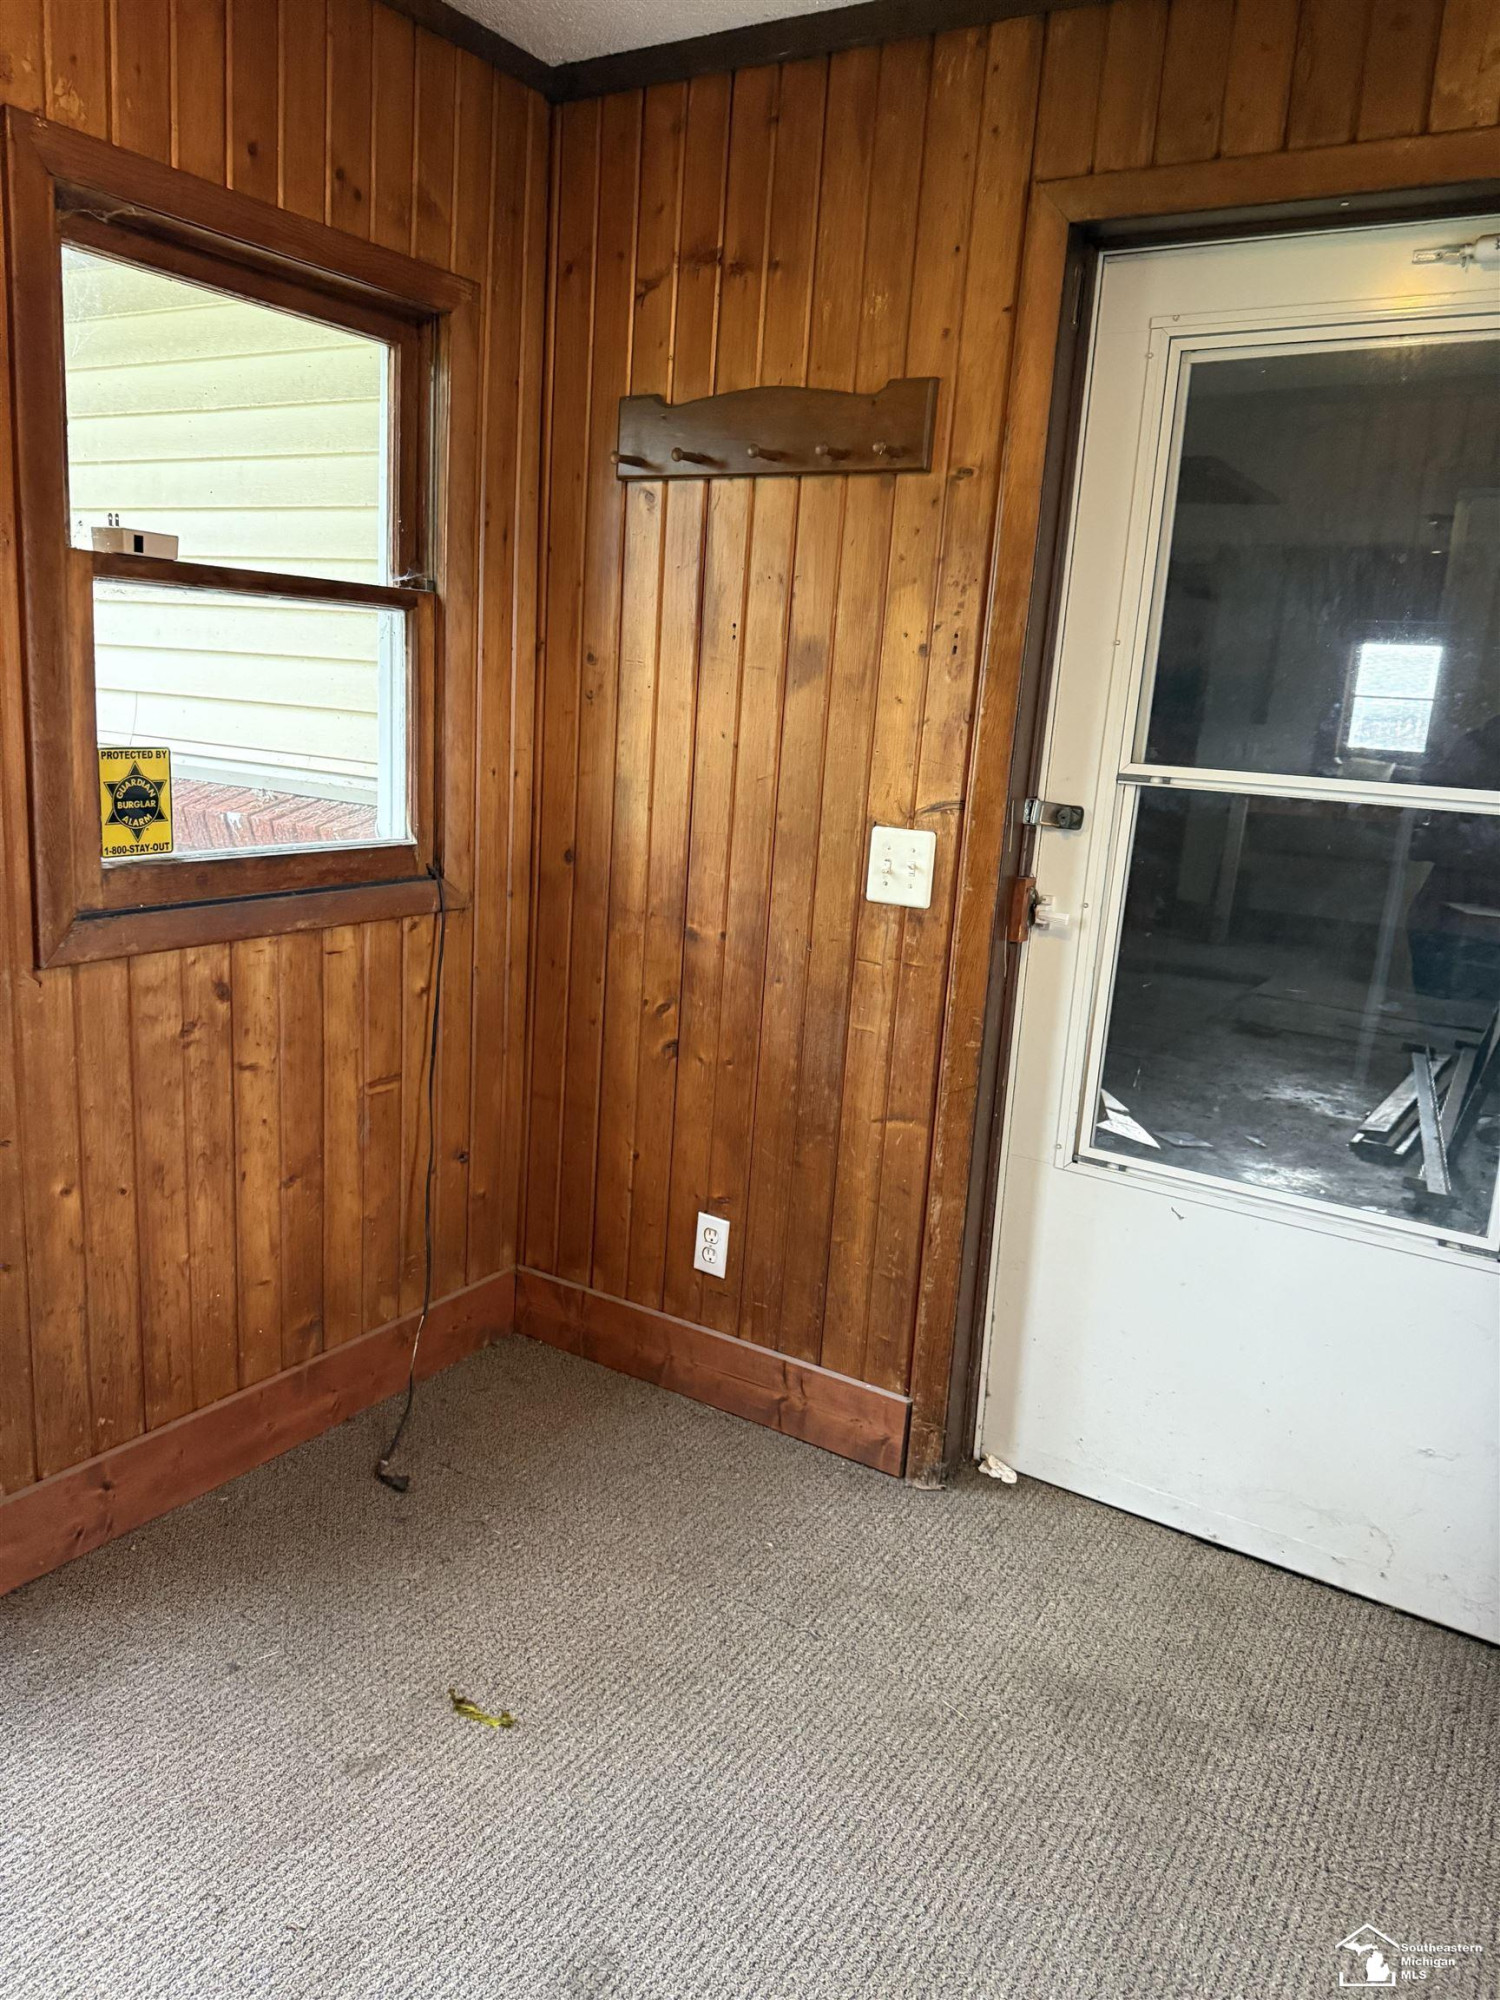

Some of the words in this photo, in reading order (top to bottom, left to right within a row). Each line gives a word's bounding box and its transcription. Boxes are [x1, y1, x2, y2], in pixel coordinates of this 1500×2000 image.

[100, 750, 153, 760] PROTECTED
[155, 750, 167, 759] BY
[116, 778, 156, 799] GUARDIAN
[117, 800, 156, 809] BURGLAR
[122, 813, 152, 826] ALARM
[104, 842, 170, 855] 1-800-STAY-OUT
